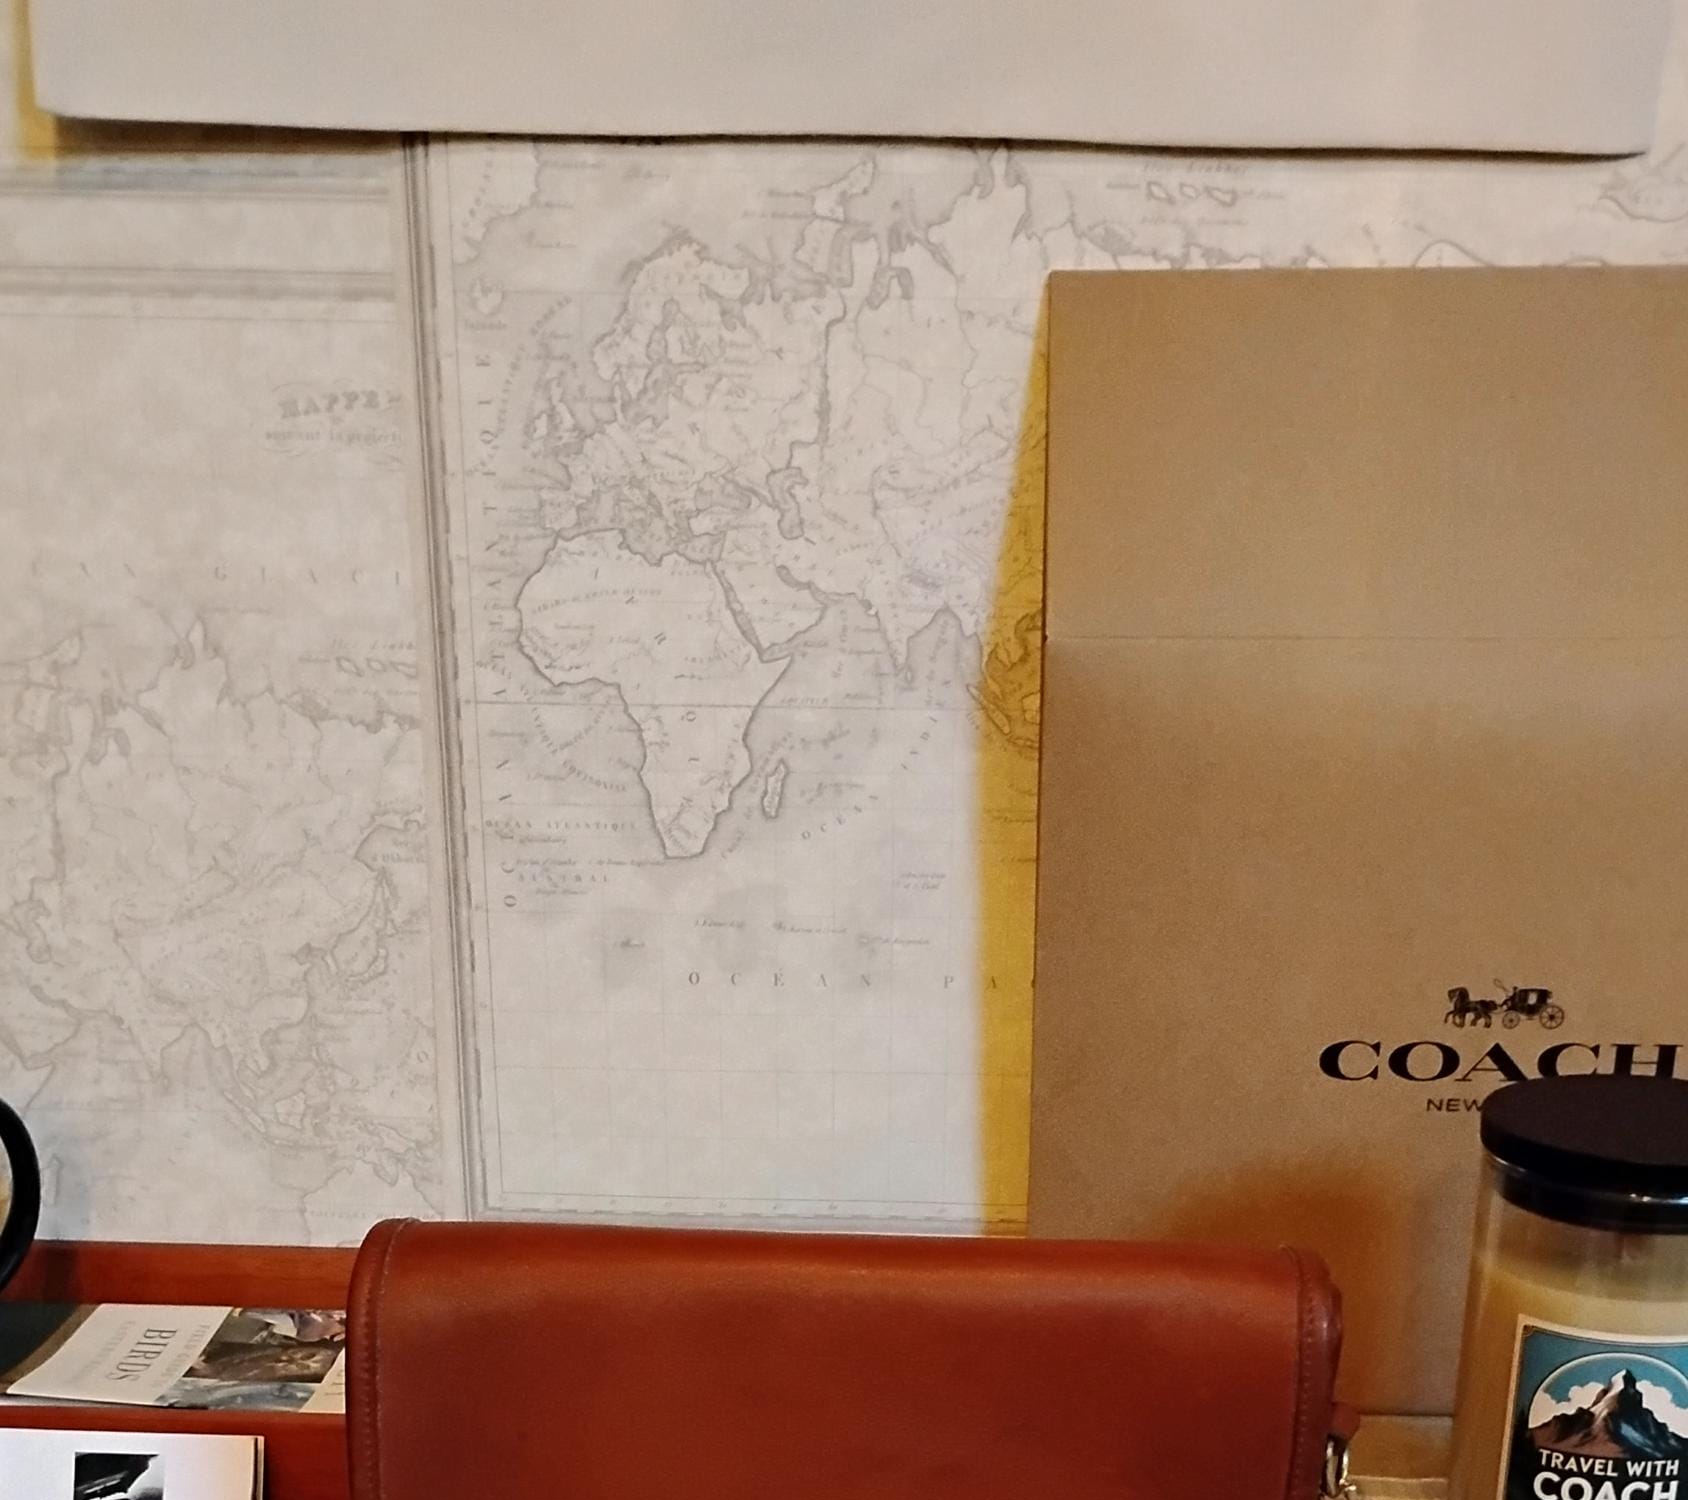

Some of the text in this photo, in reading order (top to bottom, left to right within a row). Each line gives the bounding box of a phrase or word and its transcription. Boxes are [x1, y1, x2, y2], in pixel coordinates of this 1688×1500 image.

[1318, 1040, 1684, 1082] COACH
[1426, 1097, 1484, 1112] NEW
[105, 1328, 178, 1382] BIRDS
[1539, 1449, 1680, 1477] TRAVEL WITH
